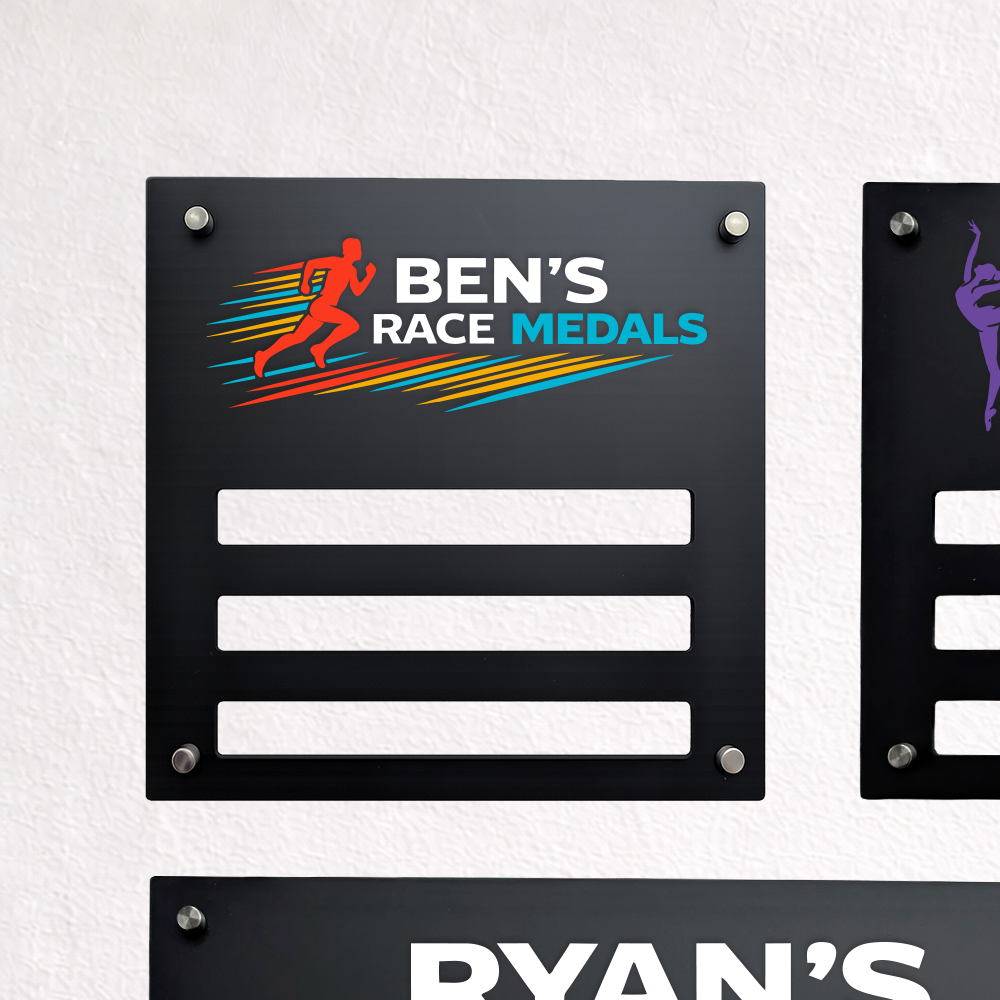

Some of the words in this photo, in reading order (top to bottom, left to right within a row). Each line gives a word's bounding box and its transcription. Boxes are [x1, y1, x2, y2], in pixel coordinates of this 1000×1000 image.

[397, 257, 607, 303] BEN'S
[374, 313, 494, 344] RACE
[512, 313, 707, 345] MEDALS
